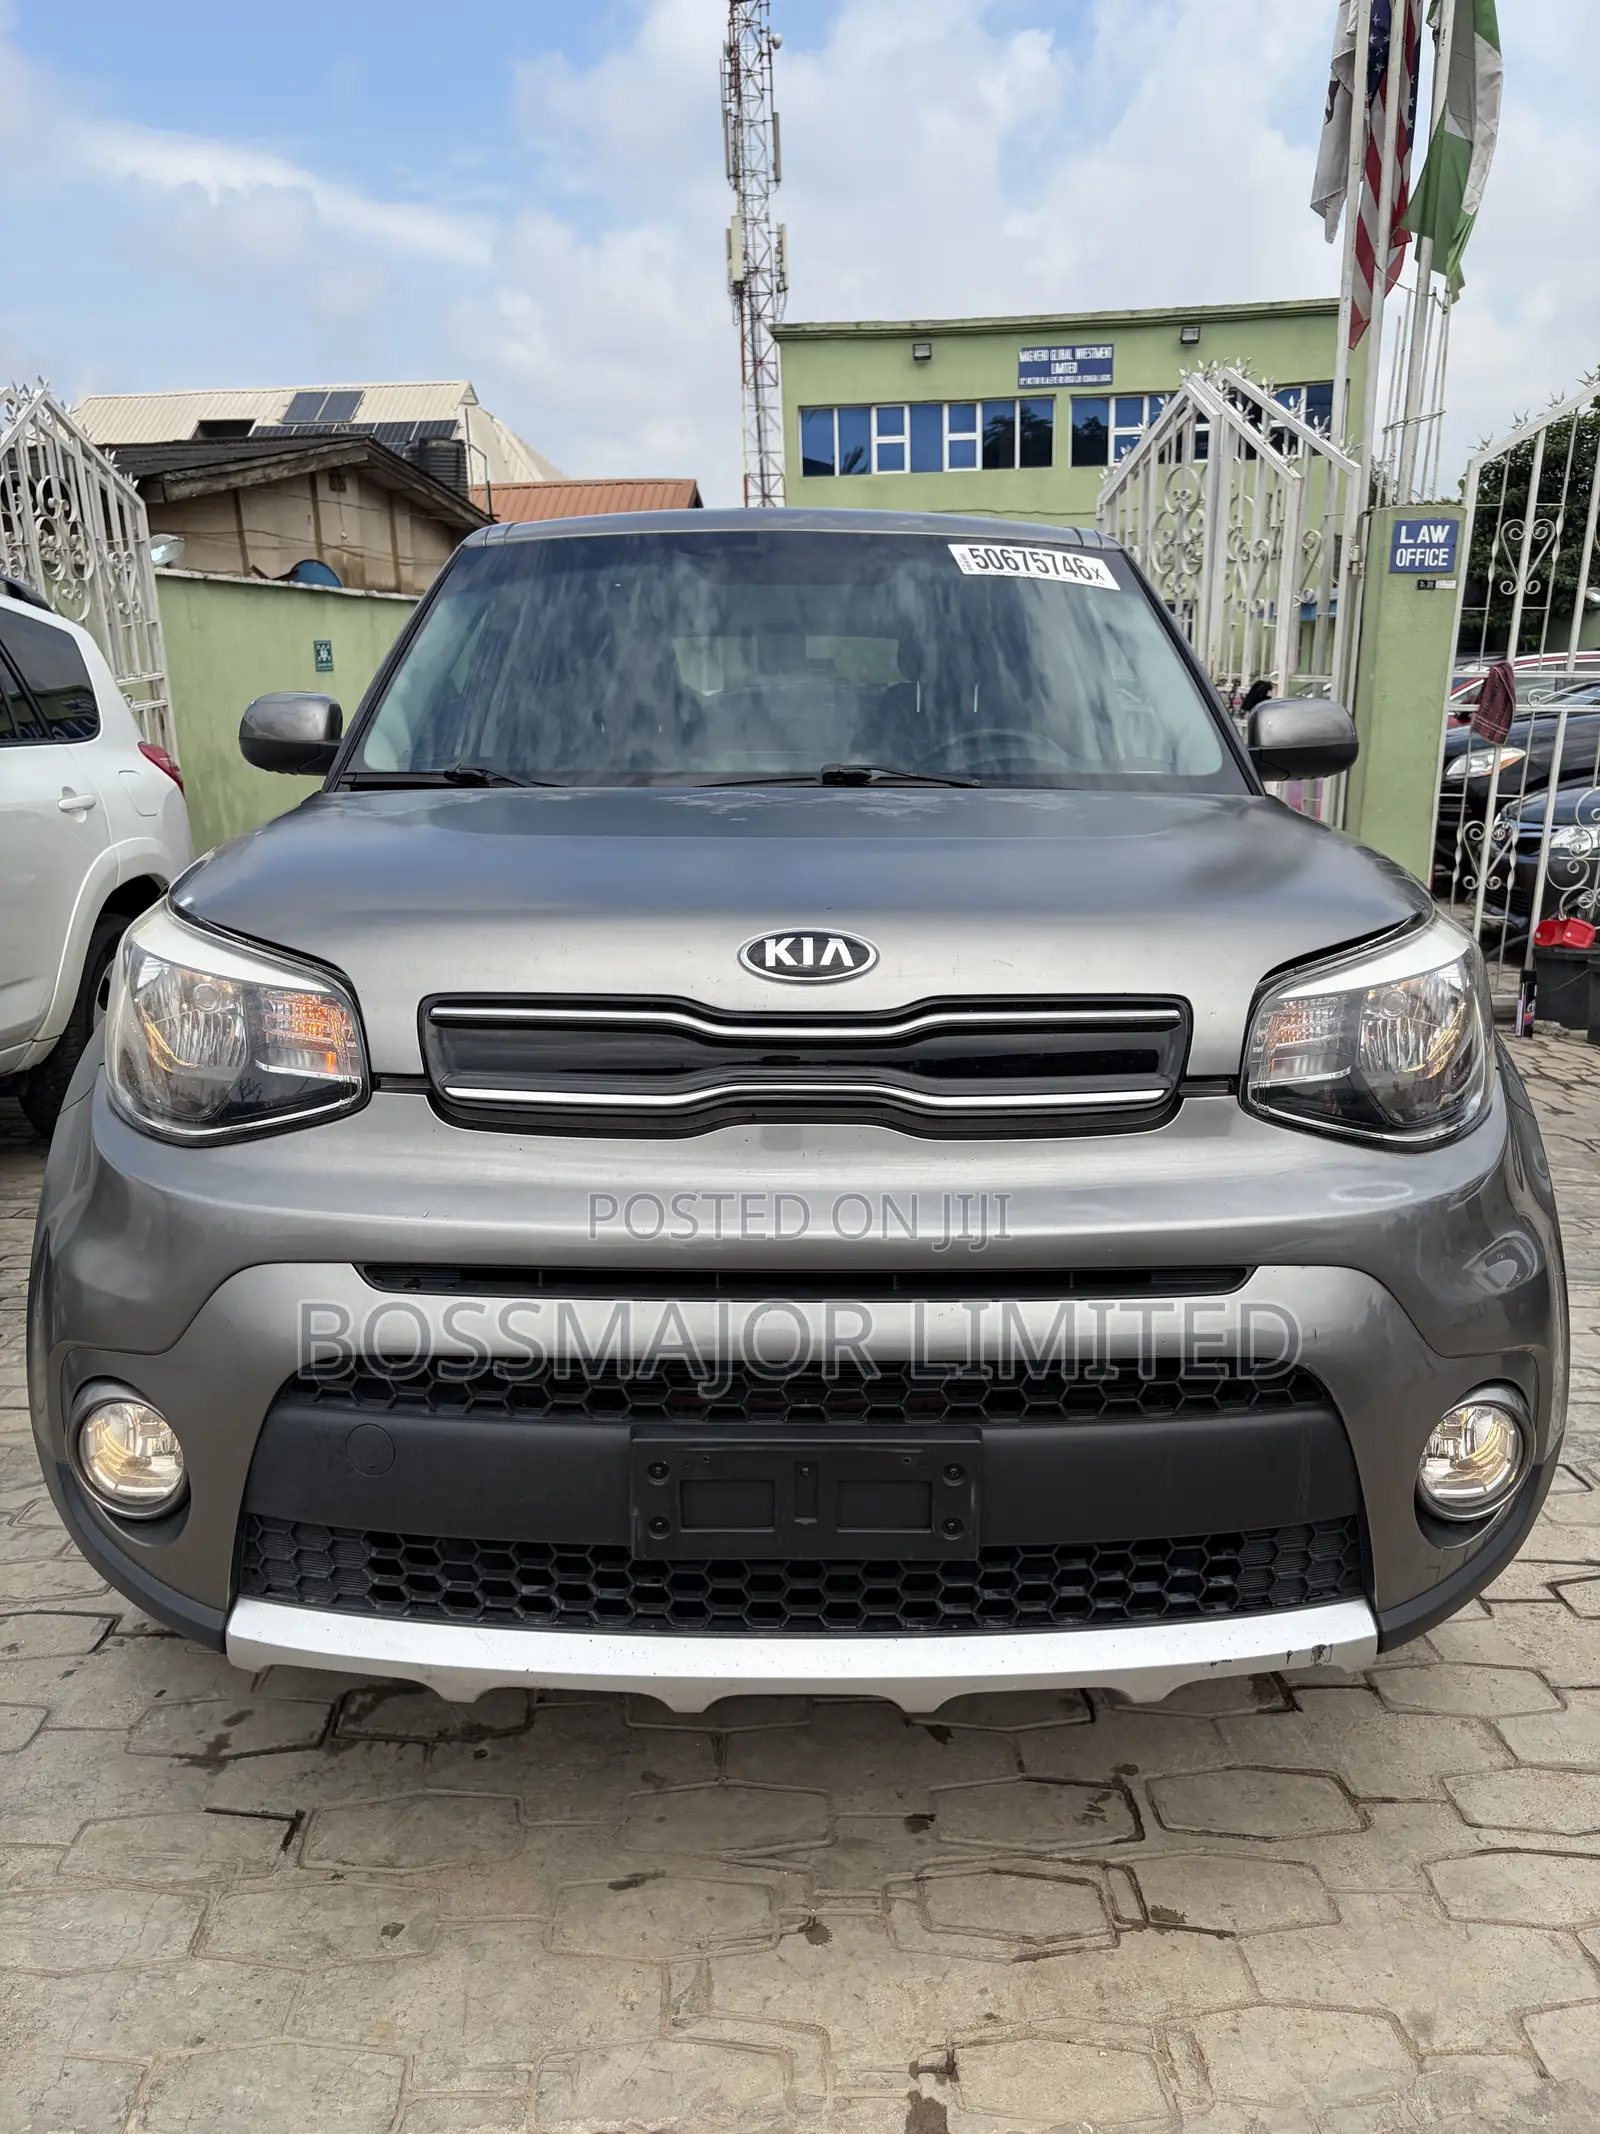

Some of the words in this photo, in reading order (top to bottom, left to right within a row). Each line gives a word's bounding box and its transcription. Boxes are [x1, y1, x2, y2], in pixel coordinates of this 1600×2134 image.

[1400, 525, 1450, 544] LAW
[1395, 548, 1449, 567] OFFICE
[763, 937, 854, 967] KIA
